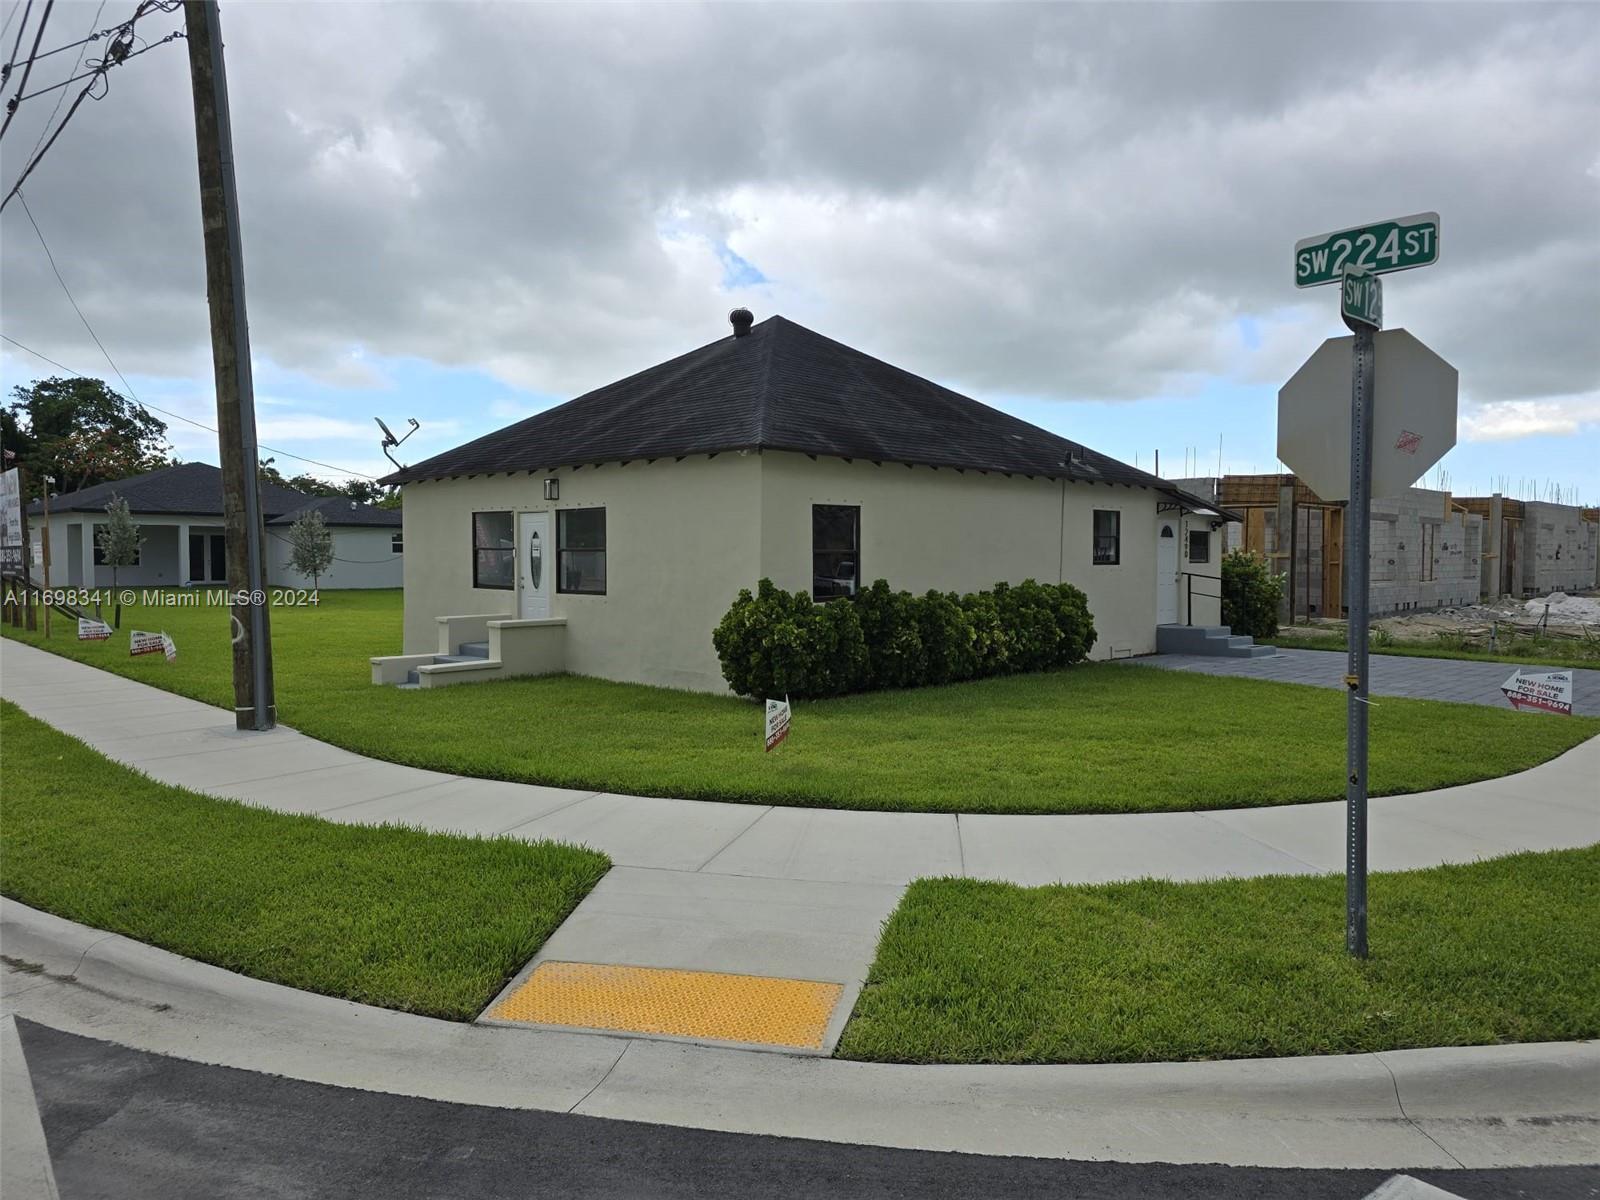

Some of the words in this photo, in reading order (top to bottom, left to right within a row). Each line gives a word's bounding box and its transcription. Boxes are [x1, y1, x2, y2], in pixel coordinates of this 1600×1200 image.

[1298, 248, 1329, 277] SW
[1331, 228, 1400, 276] 224
[1404, 227, 1434, 256] ST
[1346, 279, 1362, 307] SW
[1515, 678, 1536, 687] NEW
[1537, 682, 1564, 693] HOME
[1518, 685, 1535, 695] FOR
[1536, 690, 1559, 699] SALE
